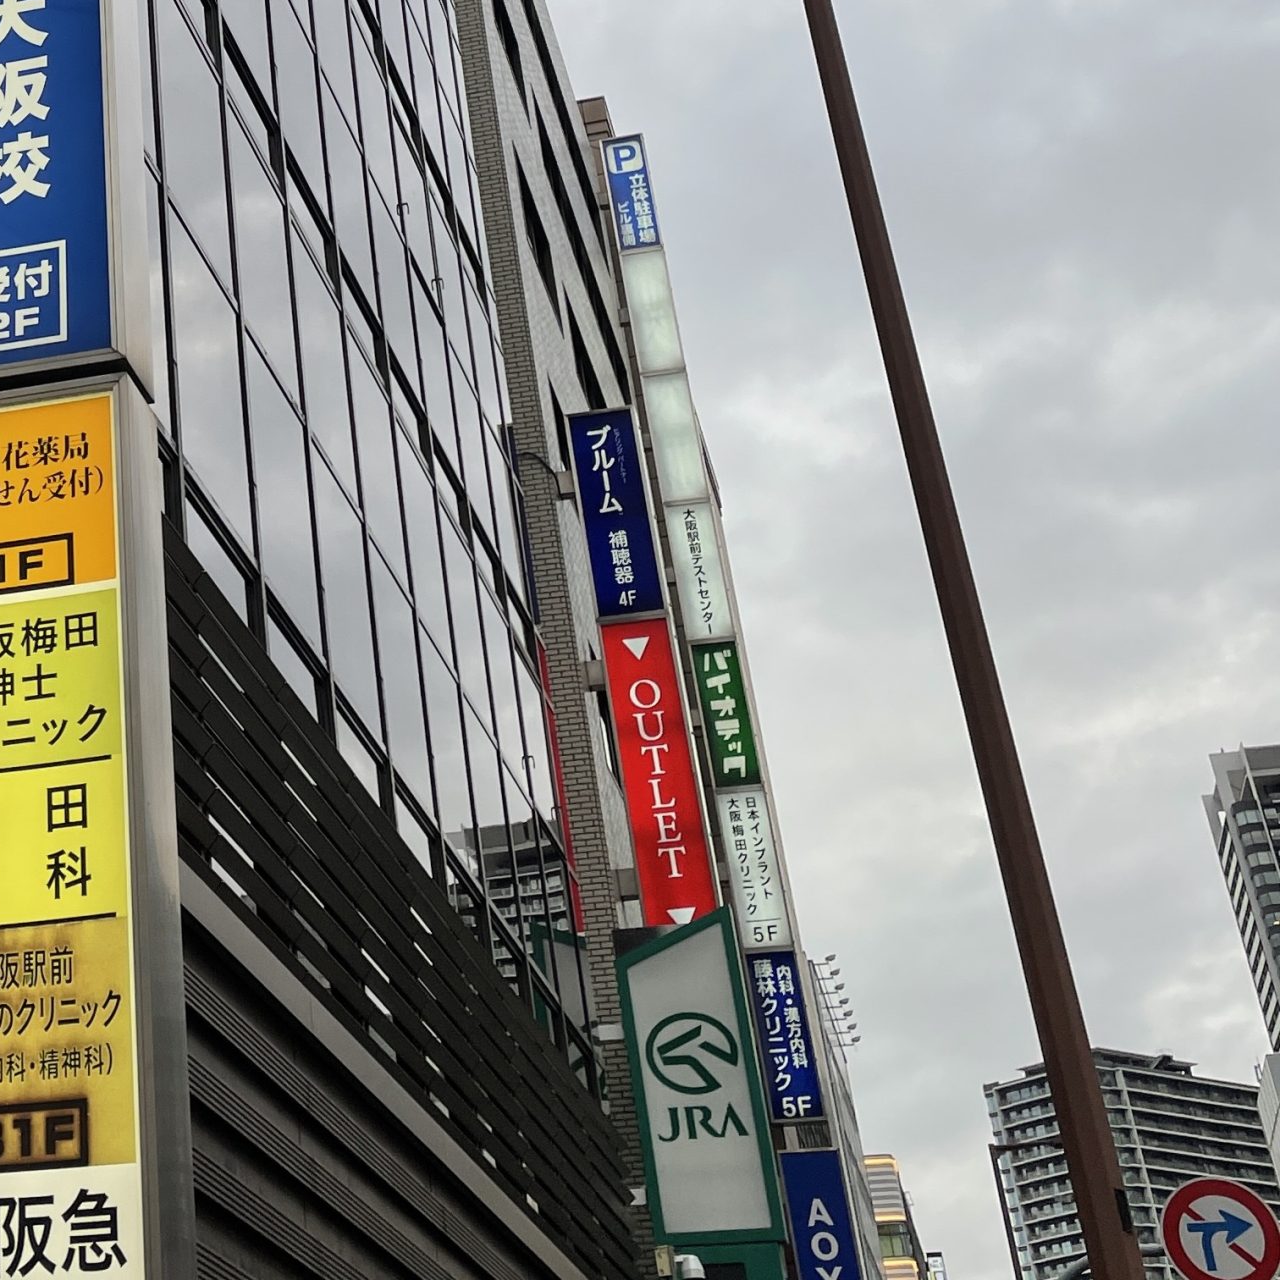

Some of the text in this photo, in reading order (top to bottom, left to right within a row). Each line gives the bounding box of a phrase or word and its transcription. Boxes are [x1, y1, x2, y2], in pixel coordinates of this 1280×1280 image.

[613, 145, 636, 171] P
[586, 424, 623, 514] ブルーム
[608, 530, 635, 584] 補聴器
[682, 508, 713, 635] 大阪駅前テストセンター
[618, 589, 637, 607] 4F
[628, 678, 687, 879] OUTLET
[727, 798, 758, 916] 大阪梅田クリニック
[752, 924, 778, 943] 5F
[658, 1102, 749, 1143] JRA
[782, 1095, 812, 1118] 5F
